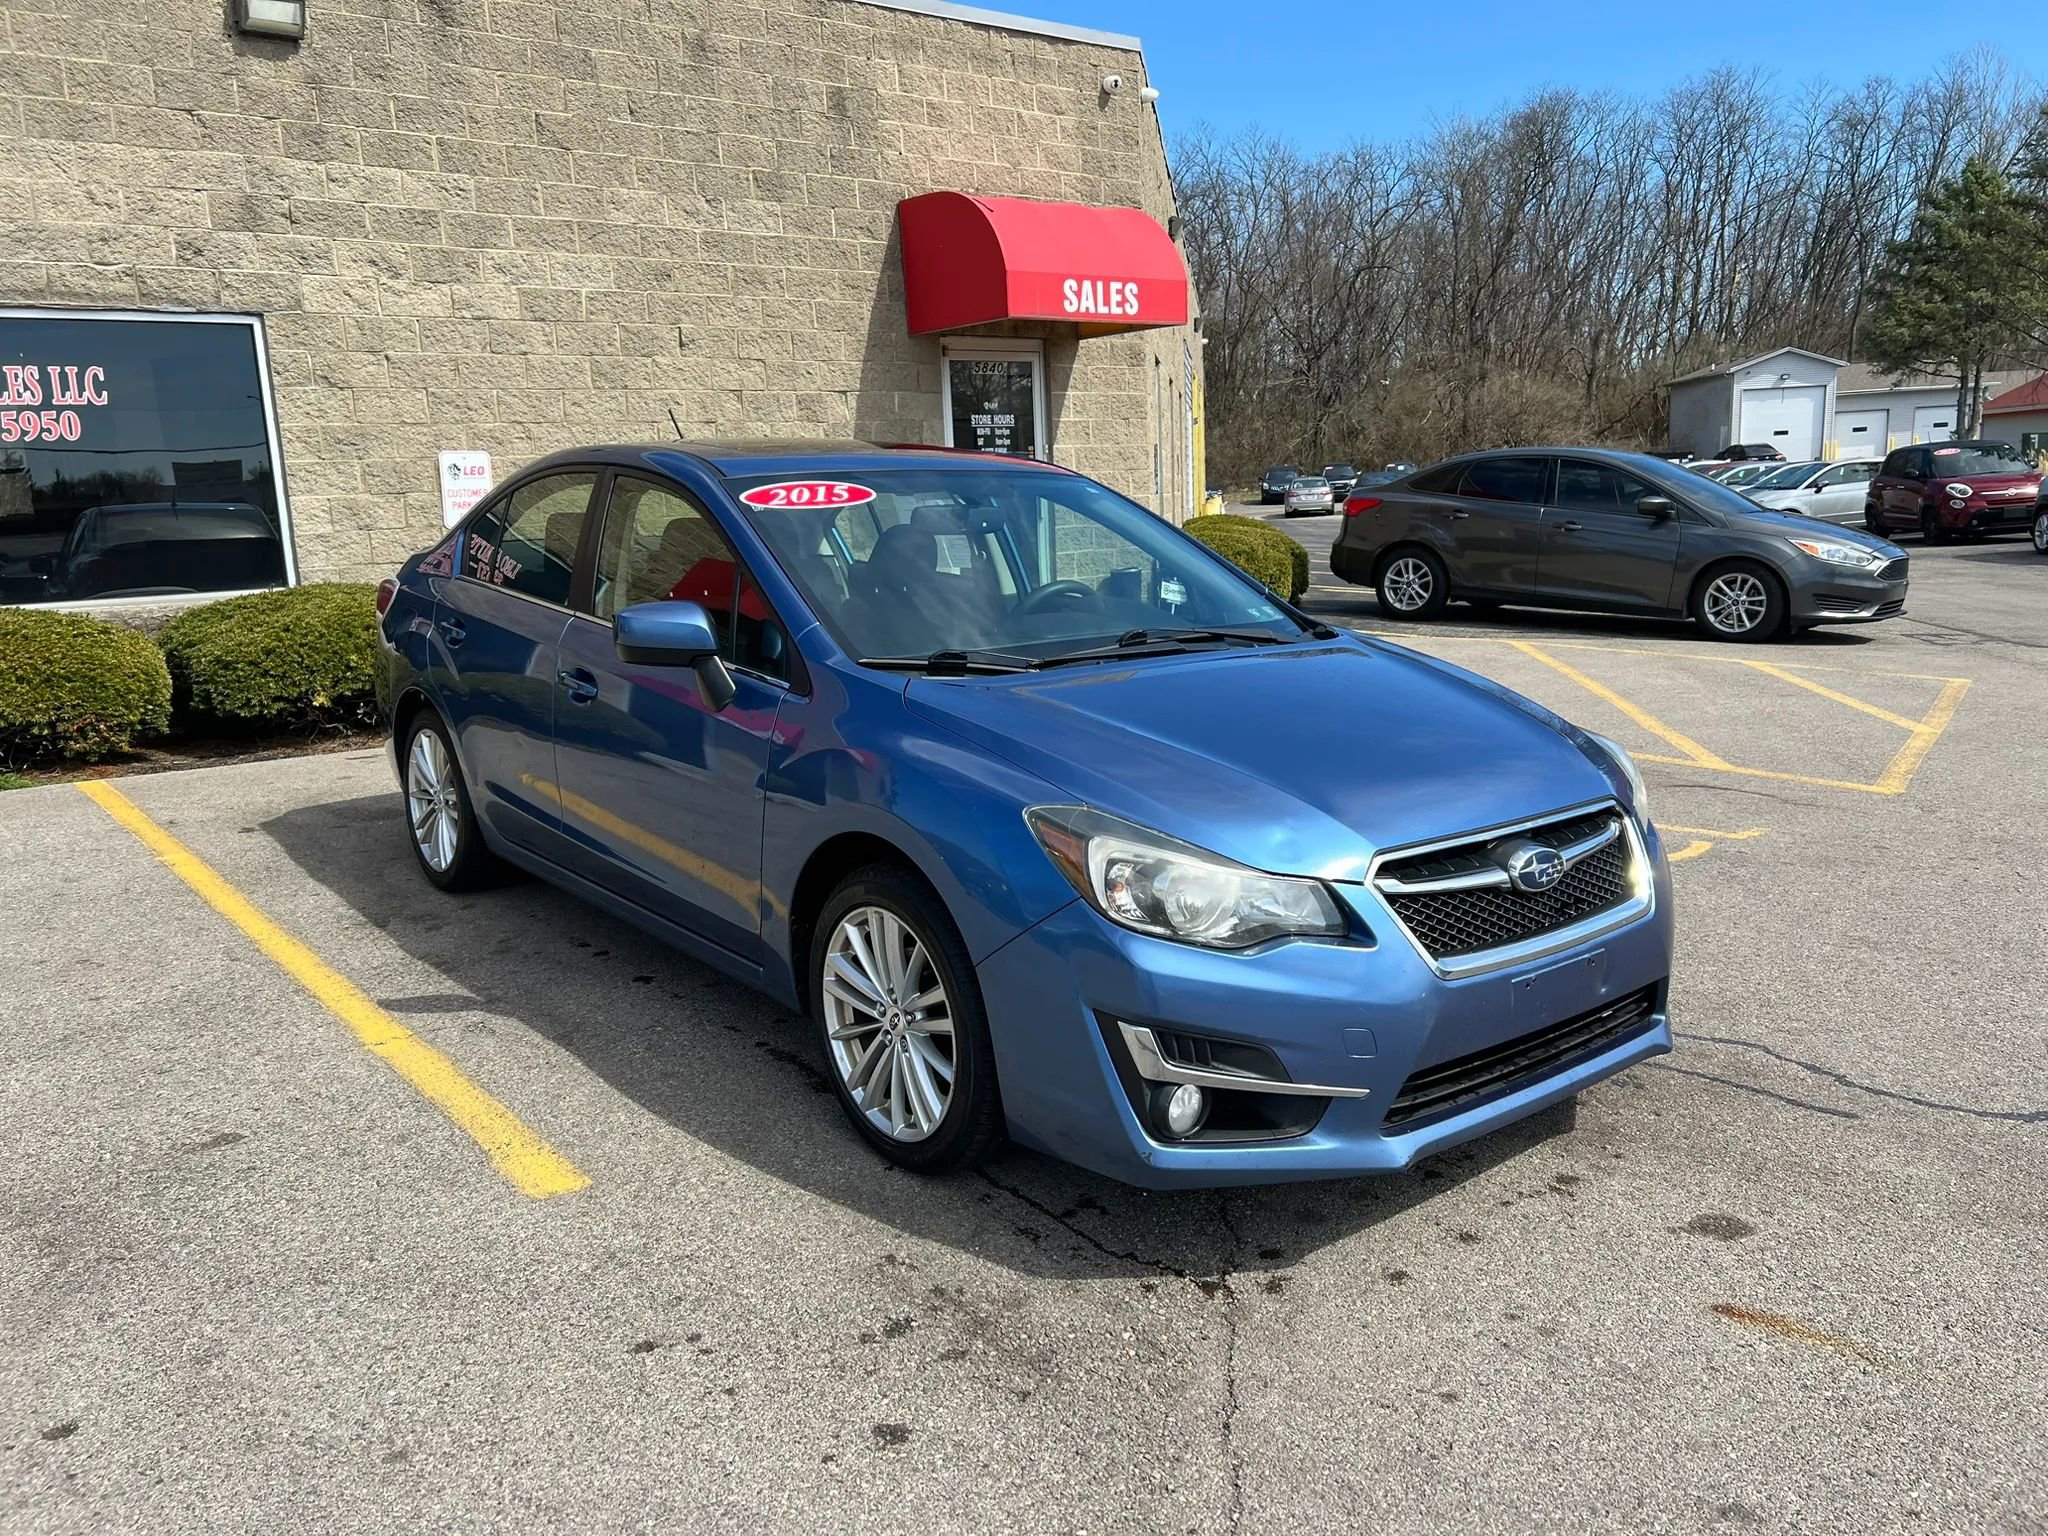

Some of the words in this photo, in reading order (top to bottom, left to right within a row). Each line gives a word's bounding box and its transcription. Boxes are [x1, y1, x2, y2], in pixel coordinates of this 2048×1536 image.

[1063, 278, 1139, 315] SALES
[974, 362, 1004, 374] 5840
[47, 365, 108, 406] LLC
[971, 414, 992, 425] STORE
[993, 414, 1015, 425] HOURS
[1, 410, 82, 442] 5950
[463, 465, 485, 476] LEO
[447, 488, 488, 498] CUSTOMER
[768, 485, 849, 505] 2015
[451, 500, 477, 511] PARK
